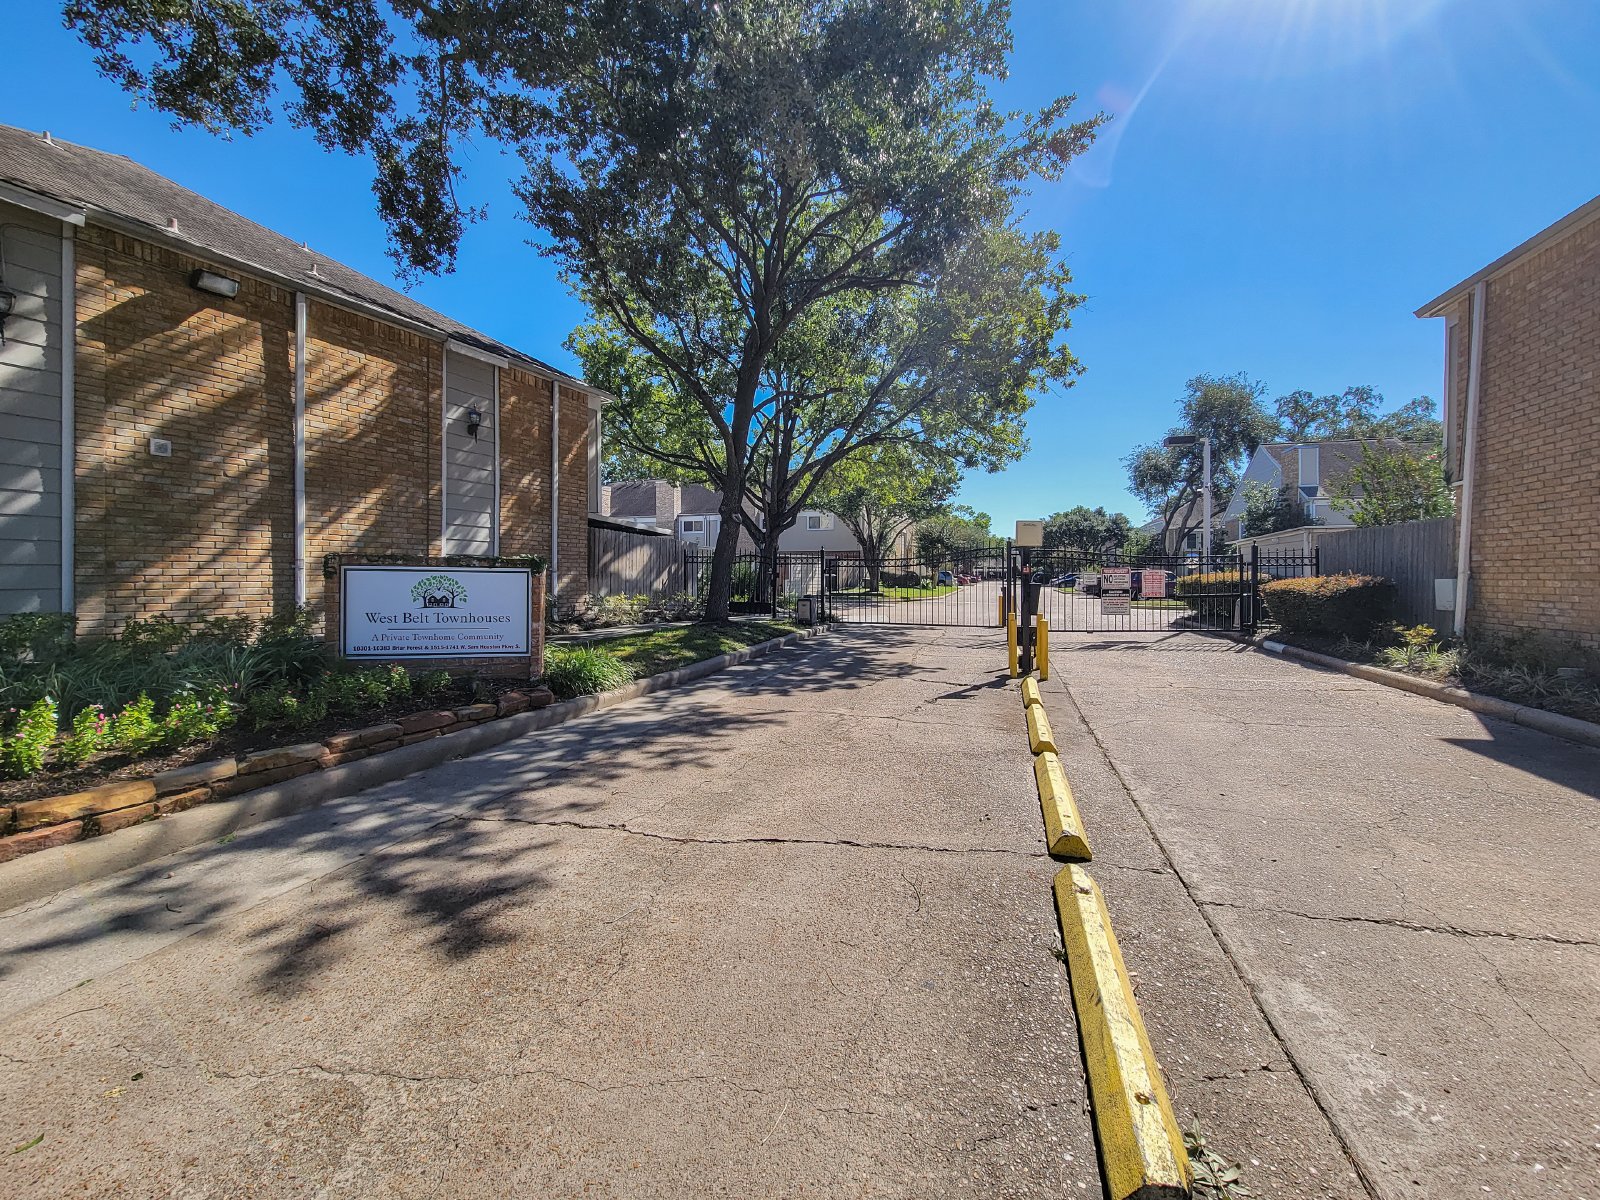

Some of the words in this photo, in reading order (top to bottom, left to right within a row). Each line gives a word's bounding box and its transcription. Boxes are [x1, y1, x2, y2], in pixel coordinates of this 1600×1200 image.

[1103, 574, 1114, 584] NO
[365, 612, 398, 624] West
[403, 612, 429, 624] Belt
[433, 612, 511, 624] Townhouses
[371, 633, 379, 642] A
[381, 633, 410, 642] Private
[413, 633, 455, 642] Townhome
[457, 632, 504, 642] Community
